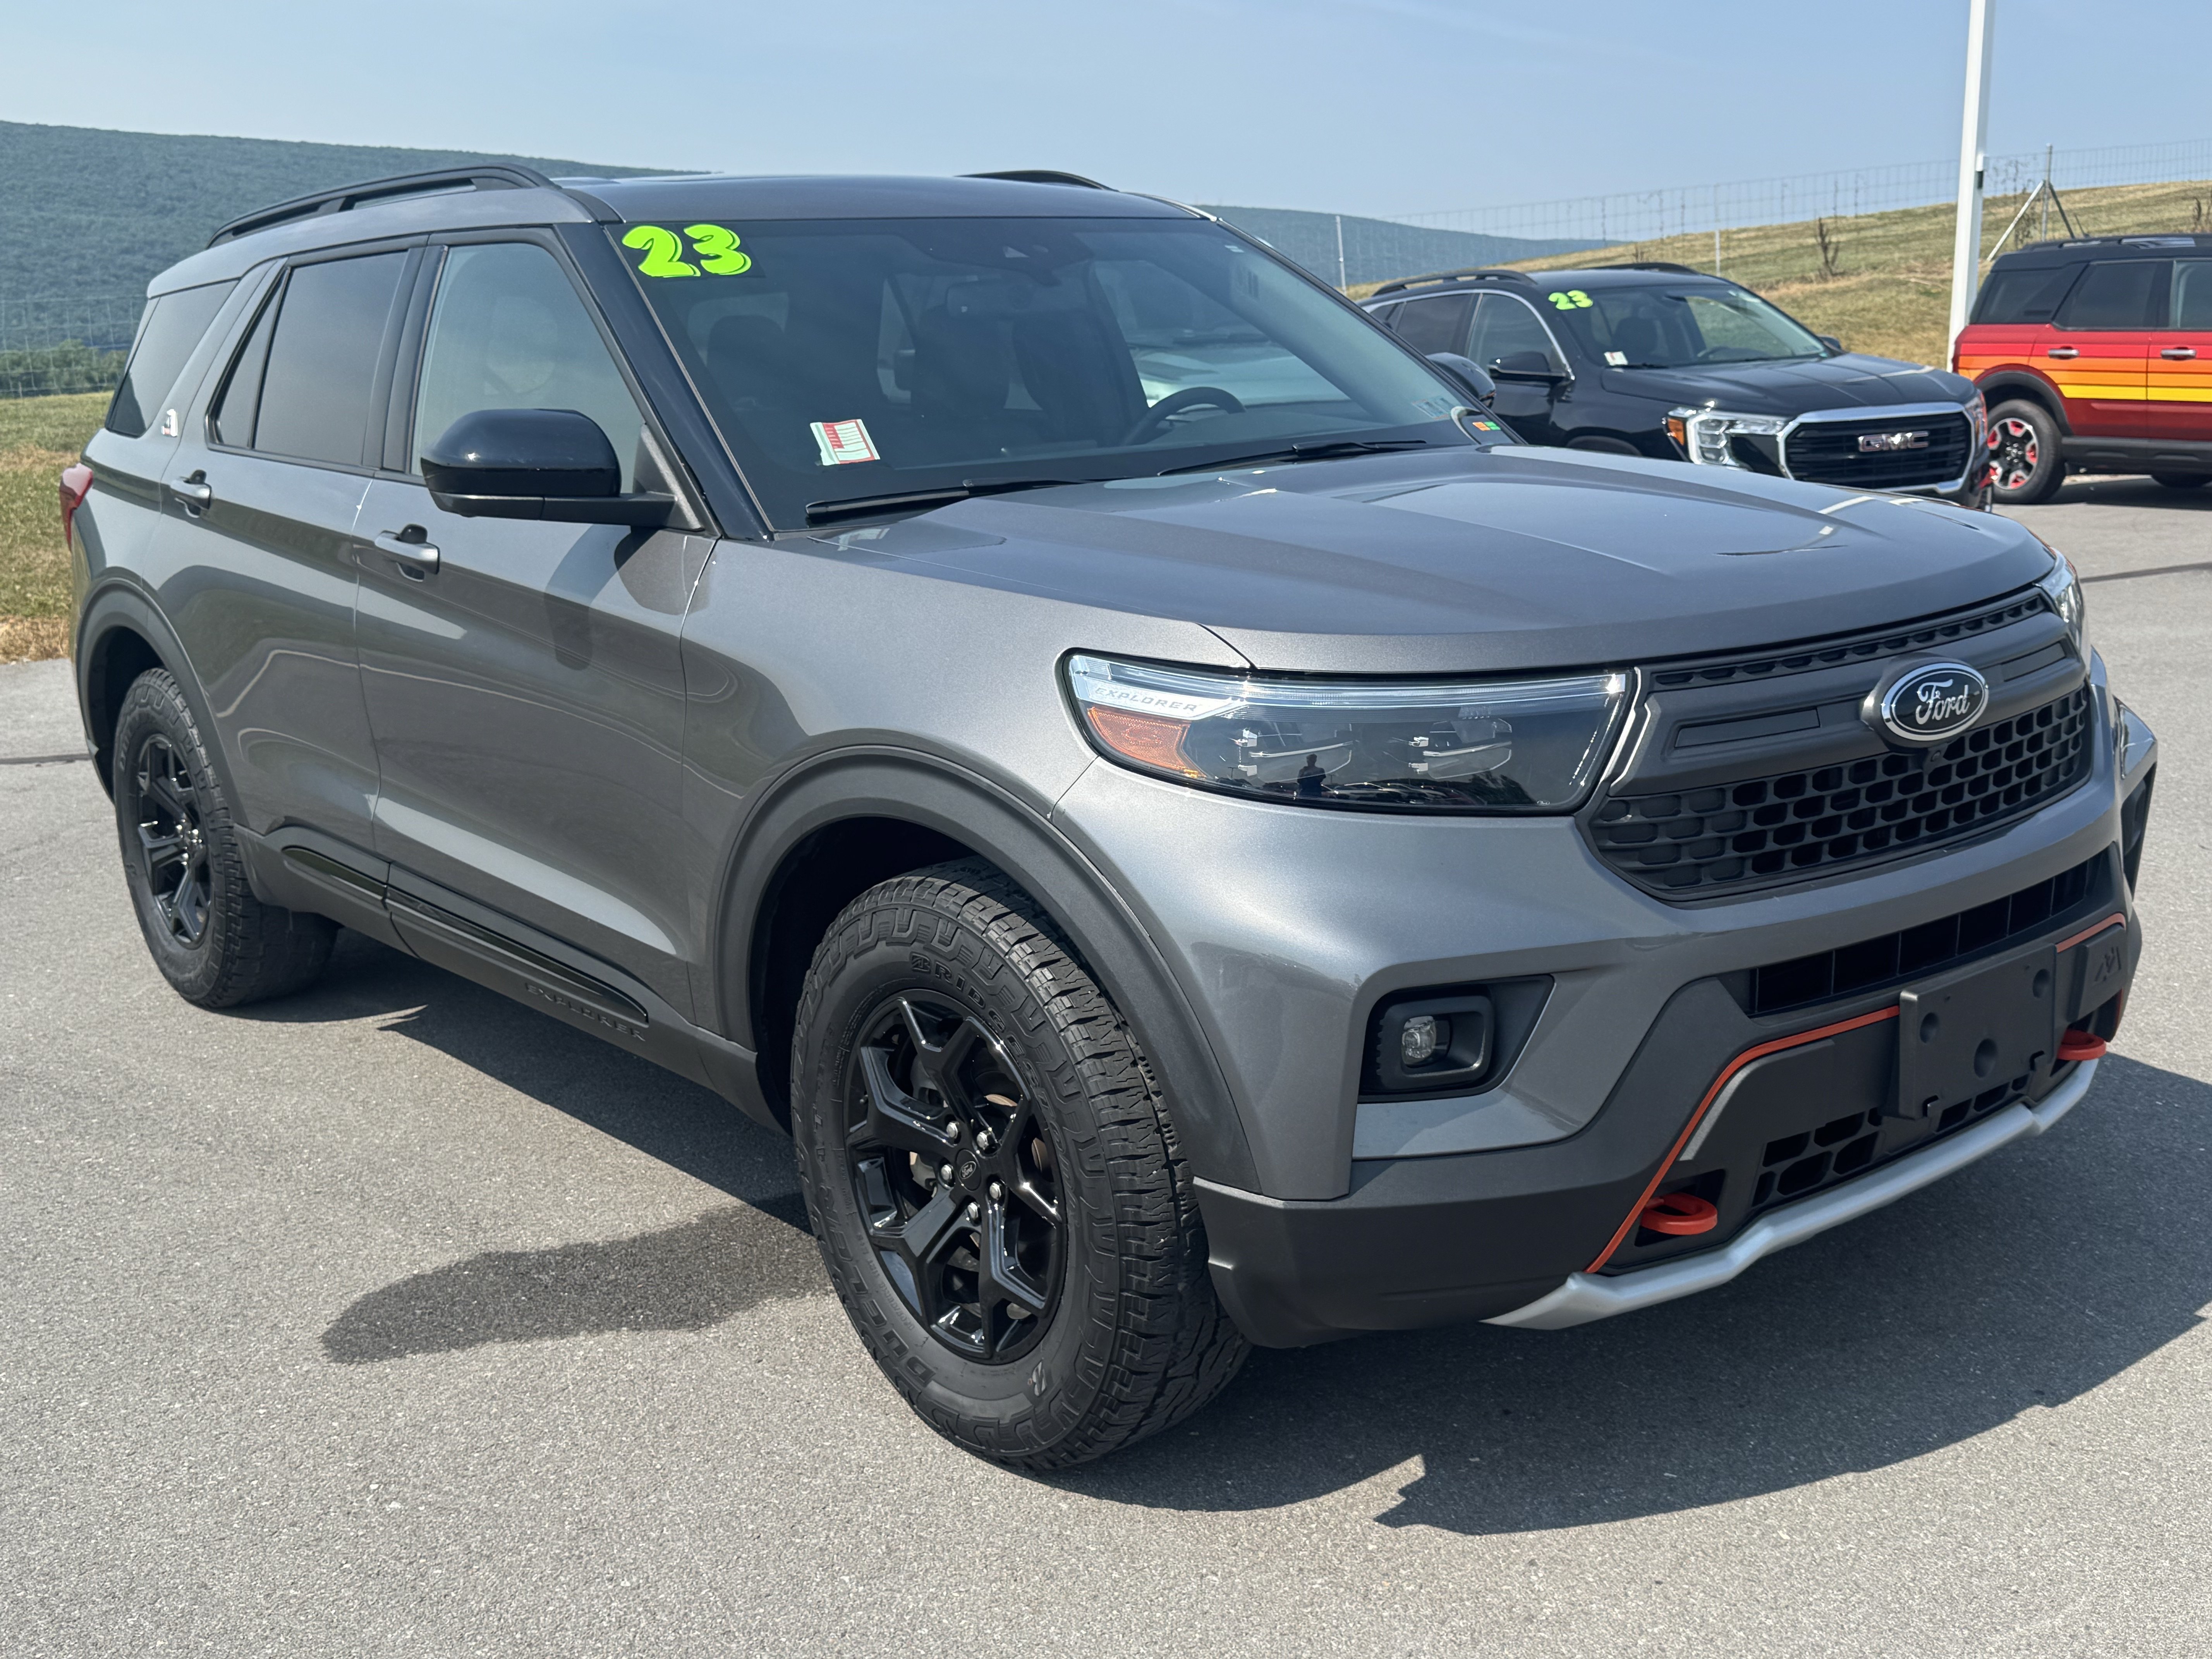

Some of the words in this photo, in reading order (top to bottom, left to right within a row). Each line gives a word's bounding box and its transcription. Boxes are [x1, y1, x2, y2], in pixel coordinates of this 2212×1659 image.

[622, 223, 752, 277] 23
[1548, 290, 1594, 310] 23
[1858, 431, 1929, 452] GMC
[1095, 687, 1198, 712] EXPLORER
[1915, 678, 1970, 725] Ford
[525, 982, 646, 1041] EXPLORER
